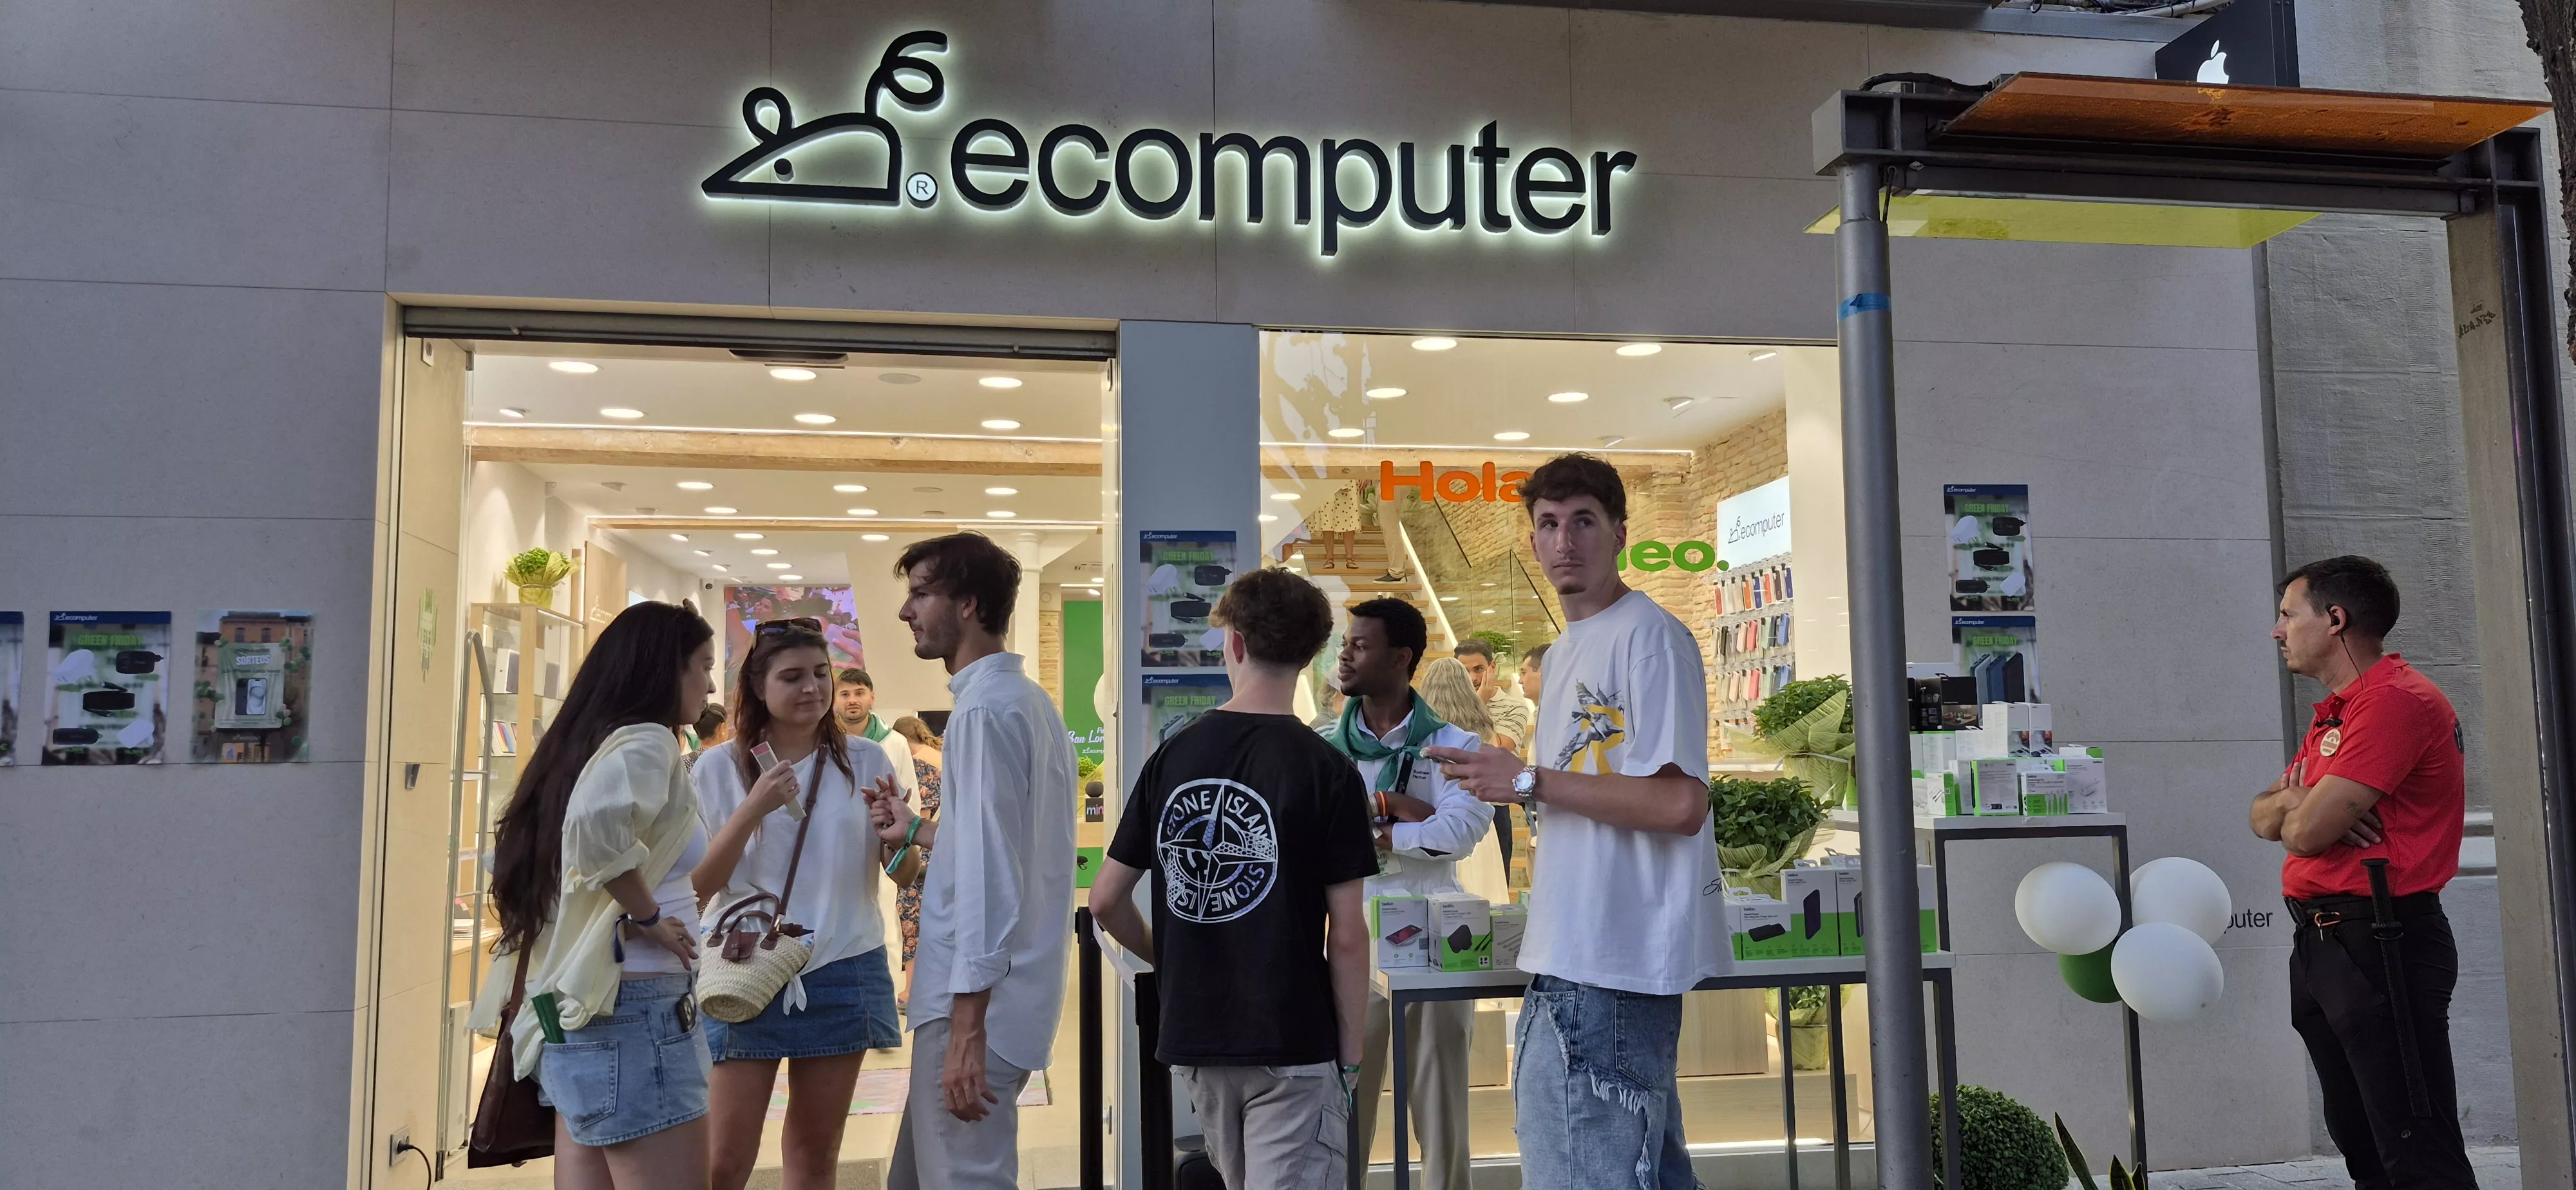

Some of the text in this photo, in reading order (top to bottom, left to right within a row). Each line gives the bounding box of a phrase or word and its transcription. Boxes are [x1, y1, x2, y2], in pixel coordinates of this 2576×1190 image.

[951, 118, 1638, 256] ecomputer
[1380, 460, 1533, 503] Hola
[1965, 504, 2009, 513] GREEN FRIDAY
[1741, 513, 1785, 539] ecomputer
[1164, 551, 1215, 560] GREEN FRIDAY
[78, 634, 144, 645] GREEN FRIDAY
[1973, 636, 2018, 645] GREEN FRIDAY
[236, 655, 270, 665] SORTEOS
[1164, 696, 1216, 706] GREEN FRIDAY
[1167, 790, 1211, 836] STONE
[1209, 864, 1266, 912] STONE
